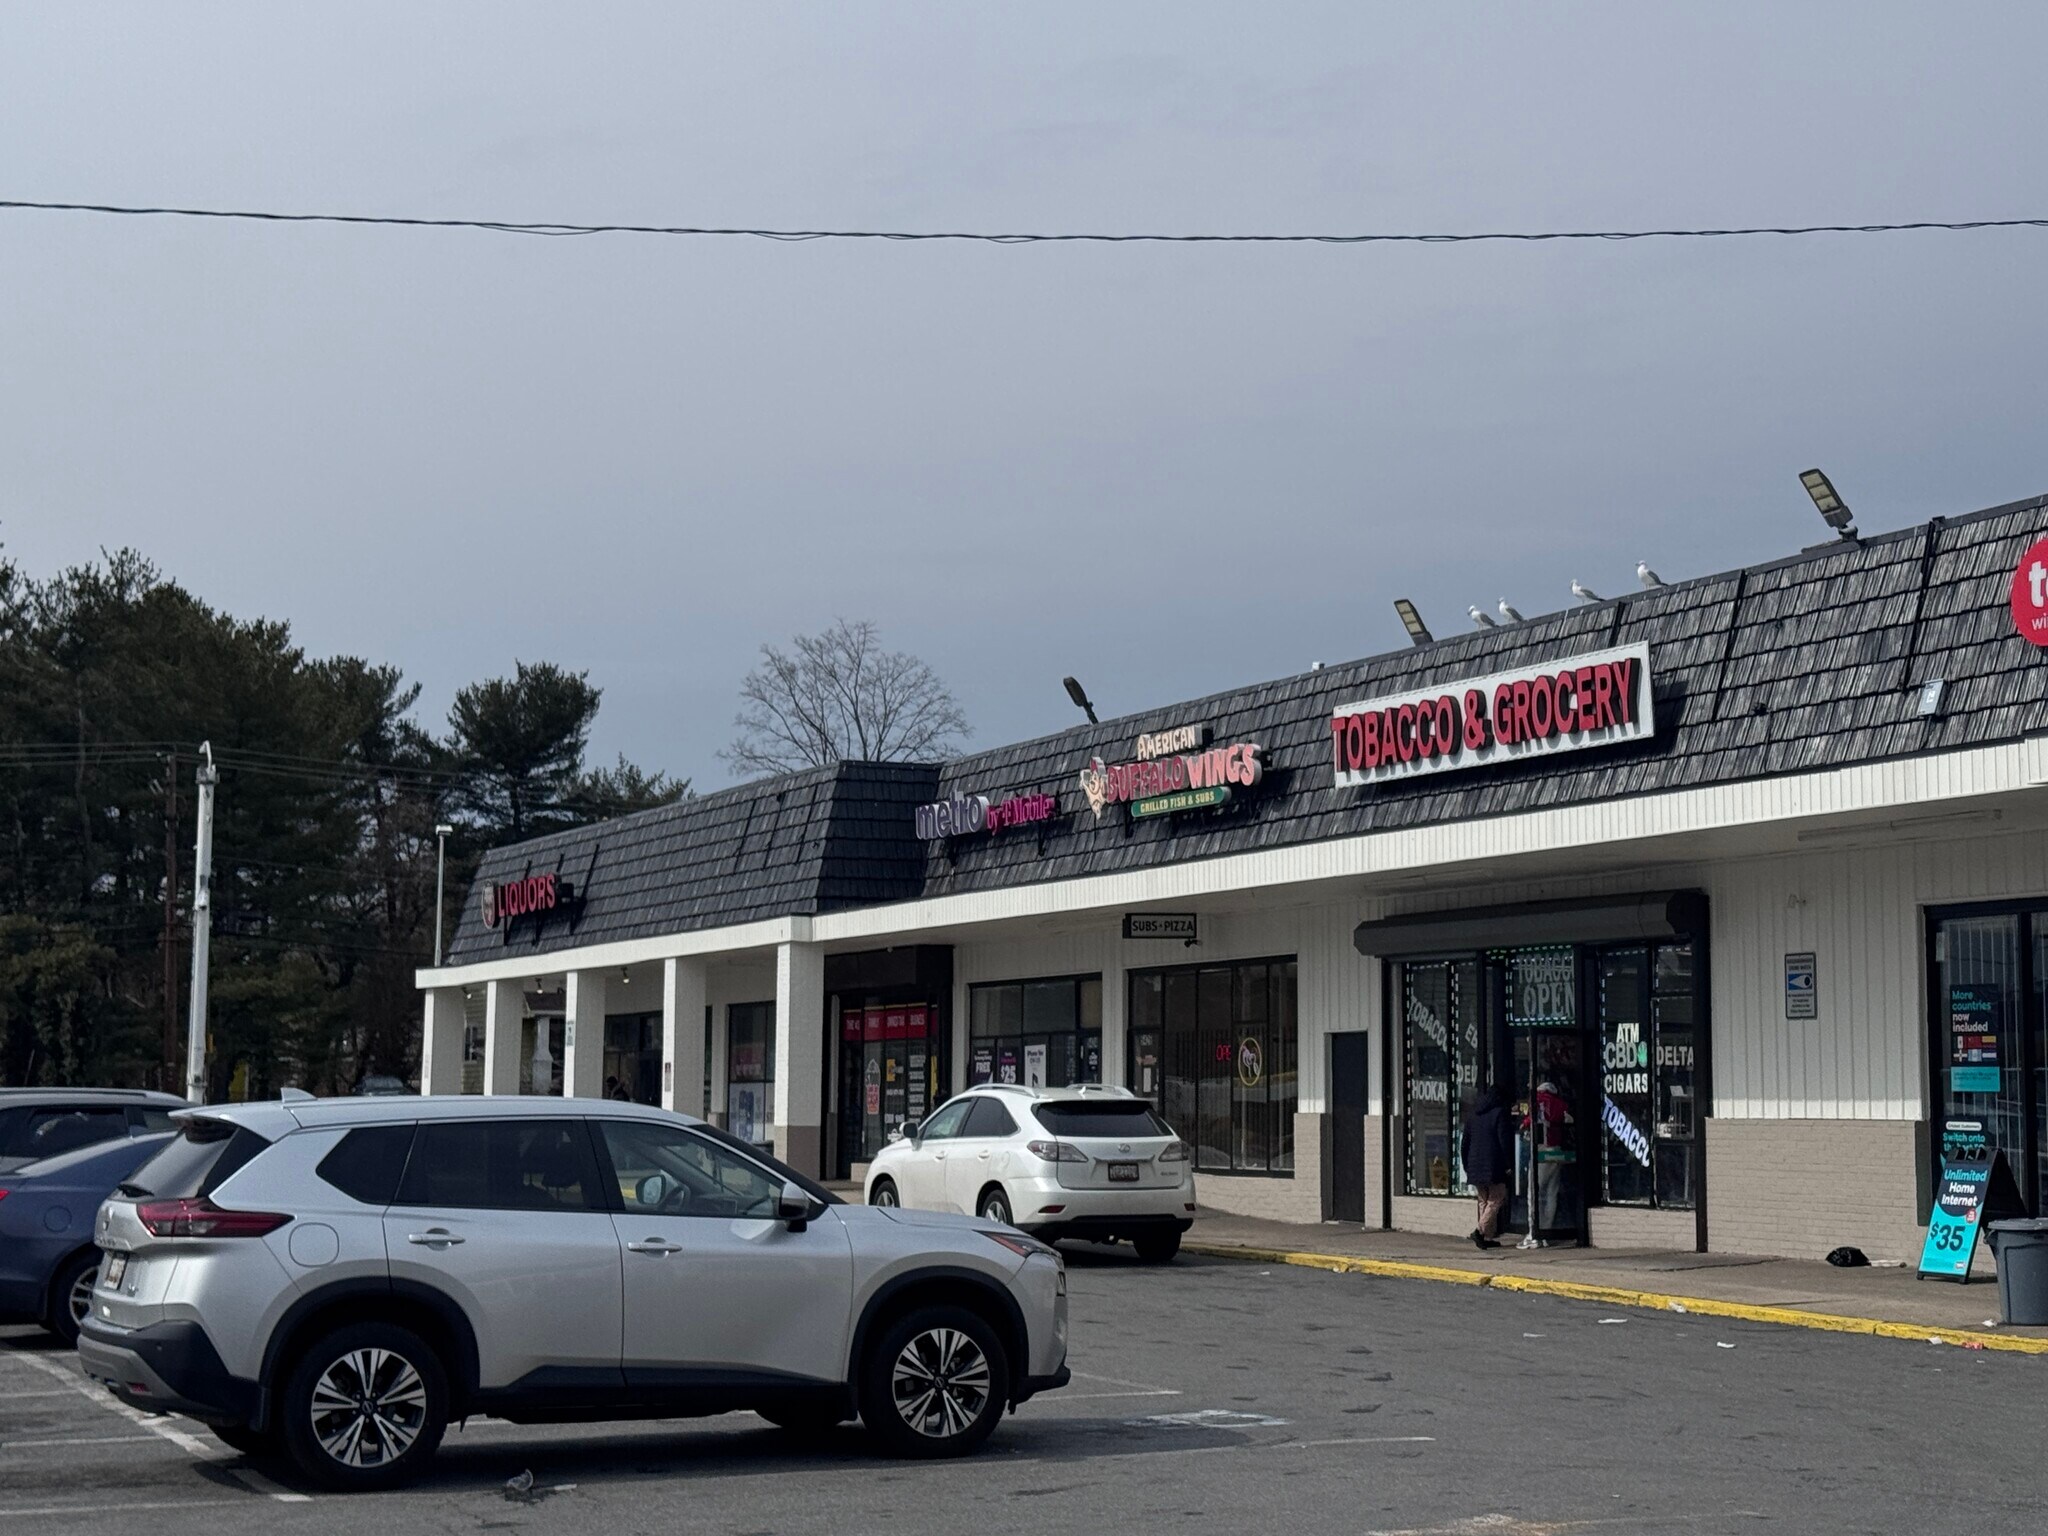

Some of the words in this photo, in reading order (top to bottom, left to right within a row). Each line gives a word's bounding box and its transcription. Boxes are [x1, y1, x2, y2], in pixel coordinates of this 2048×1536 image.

[1331, 695, 1453, 772] TOBACCO
[1464, 689, 1486, 750] &
[1493, 659, 1632, 745] GROCERY
[1137, 724, 1197, 761] AMERICAN
[1107, 755, 1185, 803] BUFFALO
[1187, 743, 1257, 789] WINGS
[1140, 800, 1169, 813] GRILLED
[1170, 796, 1187, 809] FISH
[1195, 791, 1215, 803] SUBS
[915, 790, 985, 839] metro
[498, 872, 556, 917] LIQUORS
[1163, 920, 1194, 932] PIZZA
[1523, 982, 1576, 1019] OPEN
[1952, 991, 1974, 1000] More
[1952, 1001, 1992, 1011] countries
[1616, 1023, 1640, 1043] ATM
[1952, 1022, 1988, 1032] included
[1605, 1042, 1638, 1069] CBD
[1656, 1046, 1694, 1066] DELTA
[1604, 1073, 1648, 1094] CIGARS
[1944, 1168, 1987, 1182] Unlimited
[1949, 1182, 1976, 1194] Home
[1941, 1194, 1978, 1206] Internet
[1930, 1221, 1966, 1251] $35
